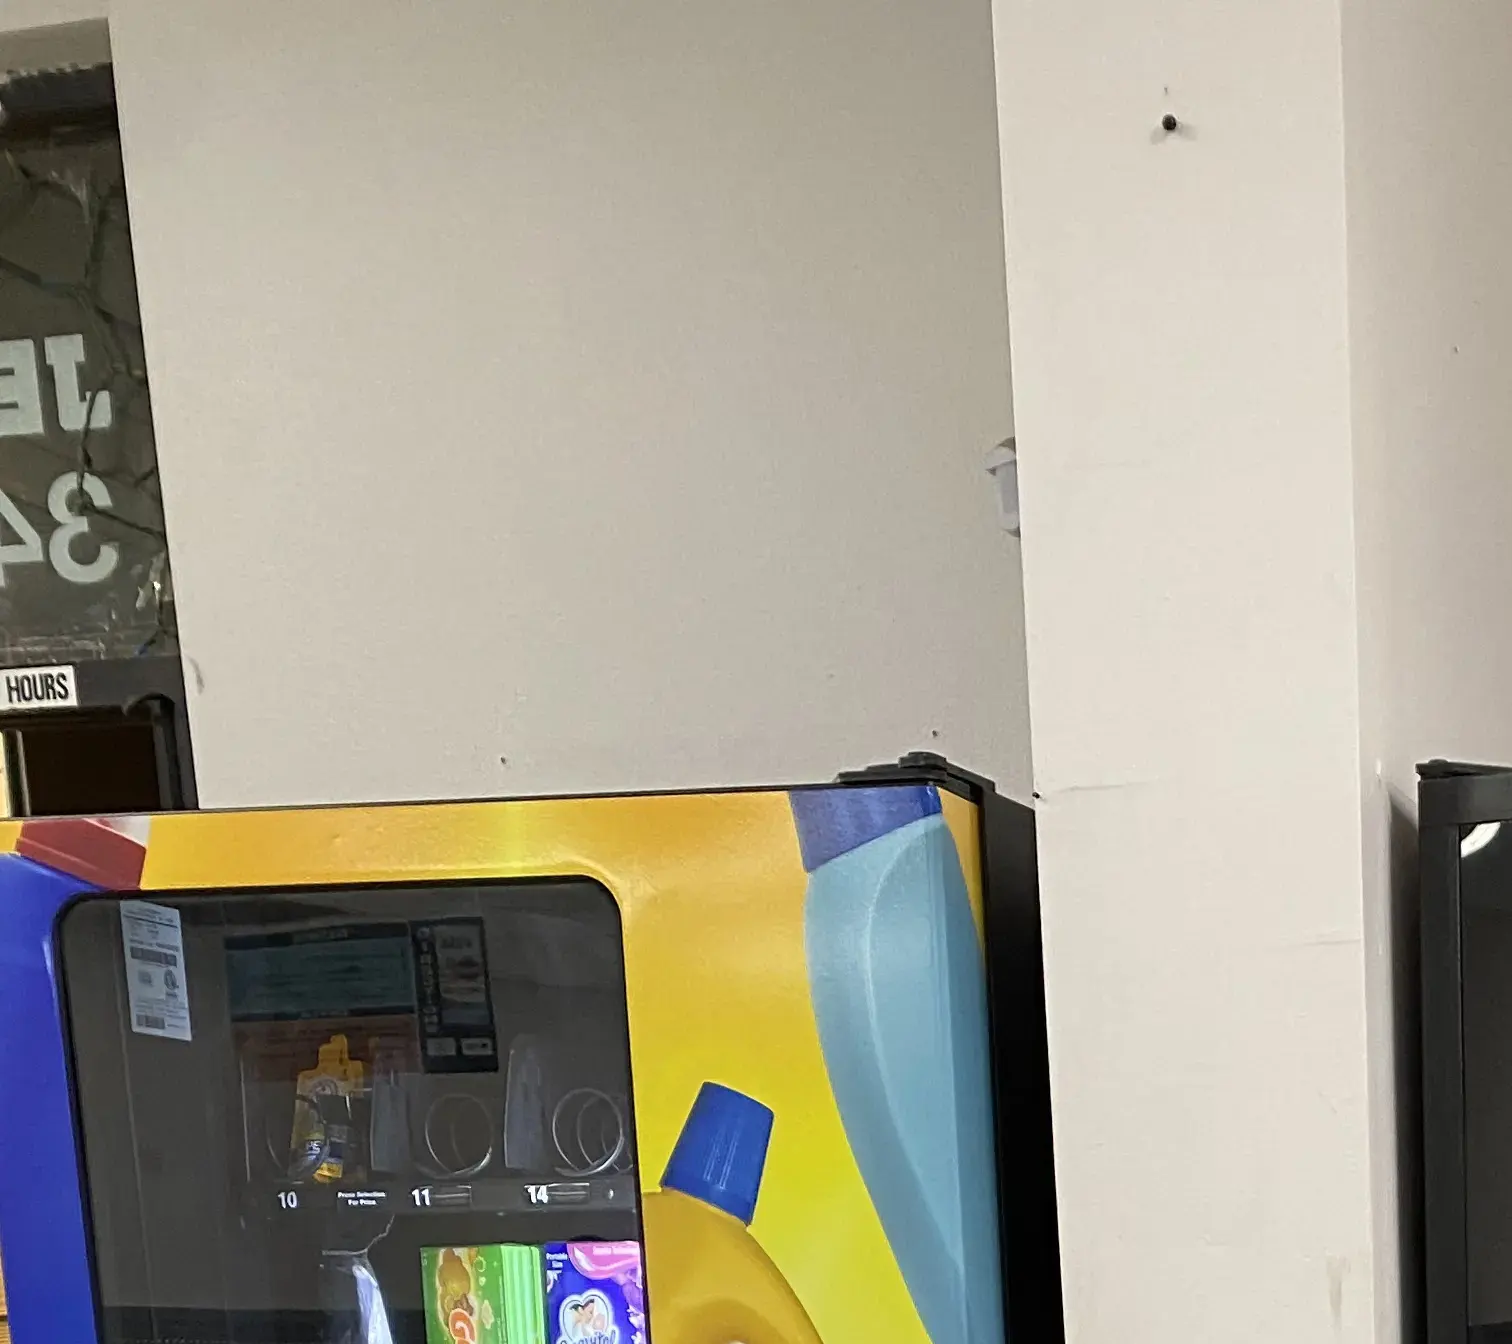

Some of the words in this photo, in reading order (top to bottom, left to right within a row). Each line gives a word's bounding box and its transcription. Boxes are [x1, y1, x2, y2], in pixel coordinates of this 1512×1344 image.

[6, 674, 69, 701] HOURS
[278, 1191, 298, 1209] 10
[411, 1188, 431, 1206] 11
[527, 1185, 549, 1204] 14
